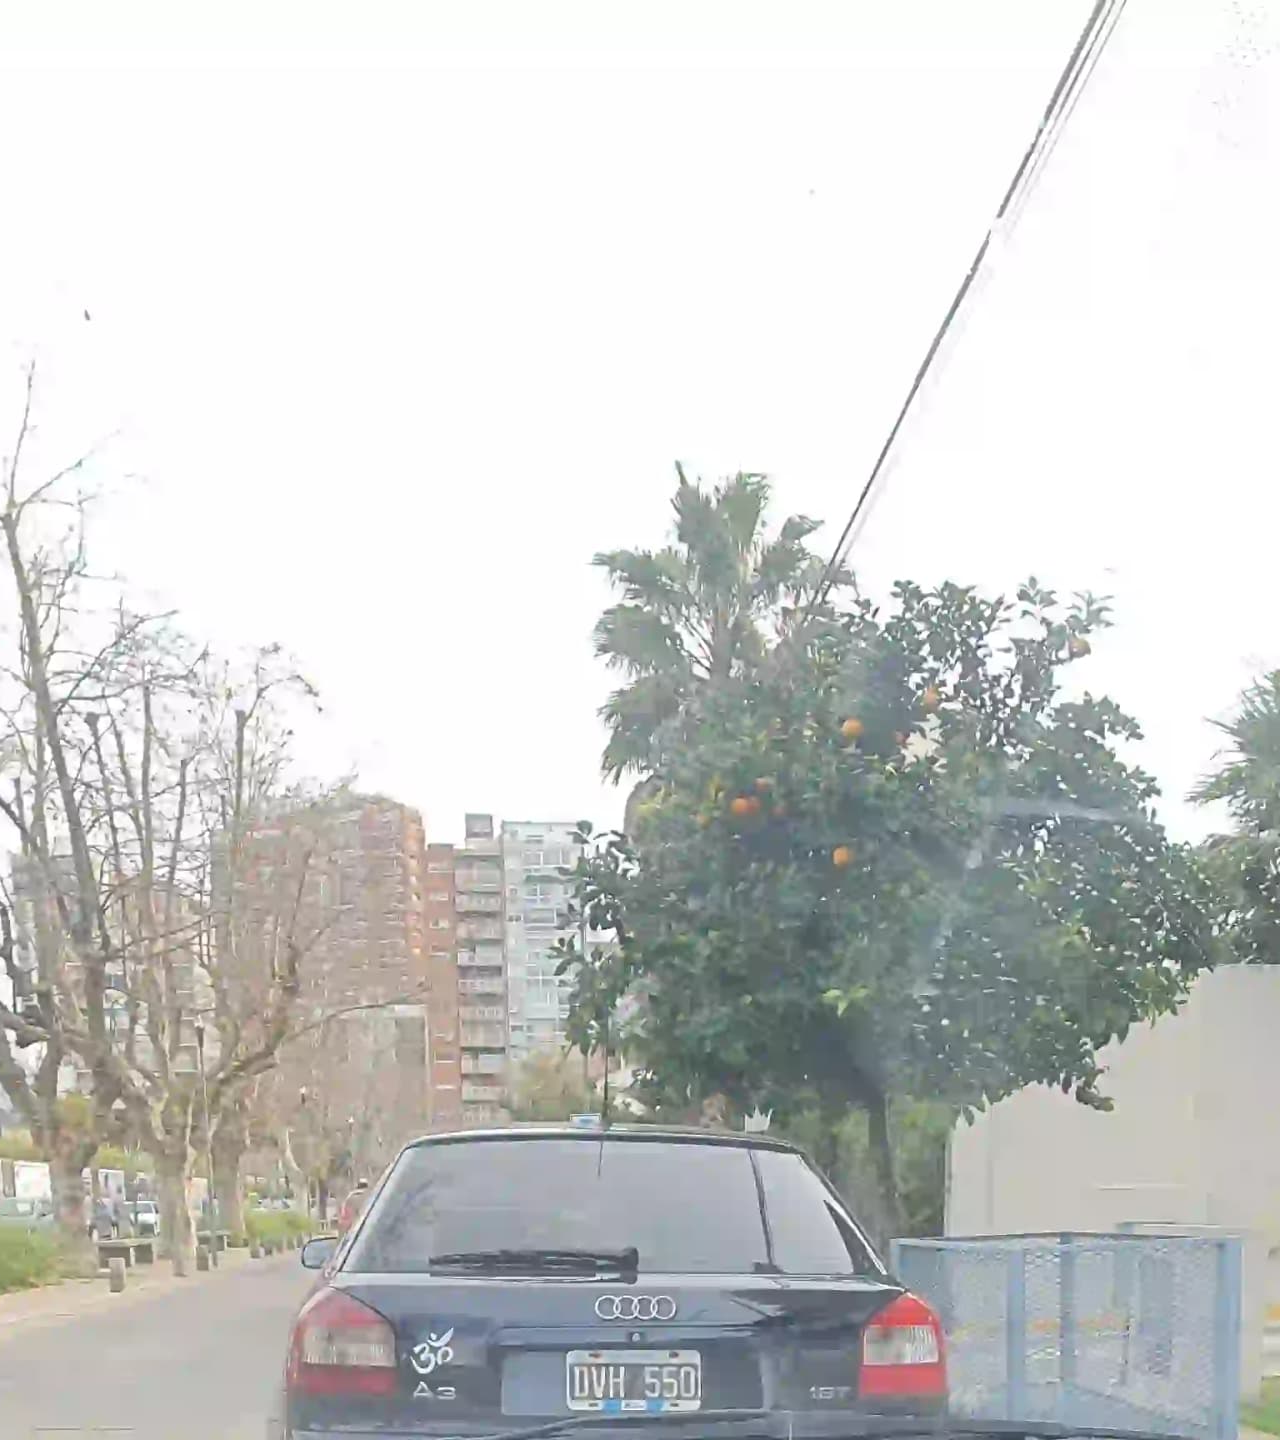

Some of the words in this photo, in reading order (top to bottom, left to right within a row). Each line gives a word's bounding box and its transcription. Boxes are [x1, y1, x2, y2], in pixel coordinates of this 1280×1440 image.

[413, 1381, 457, 1400] A3
[574, 1365, 625, 1399] DVH
[644, 1365, 696, 1398] 550
